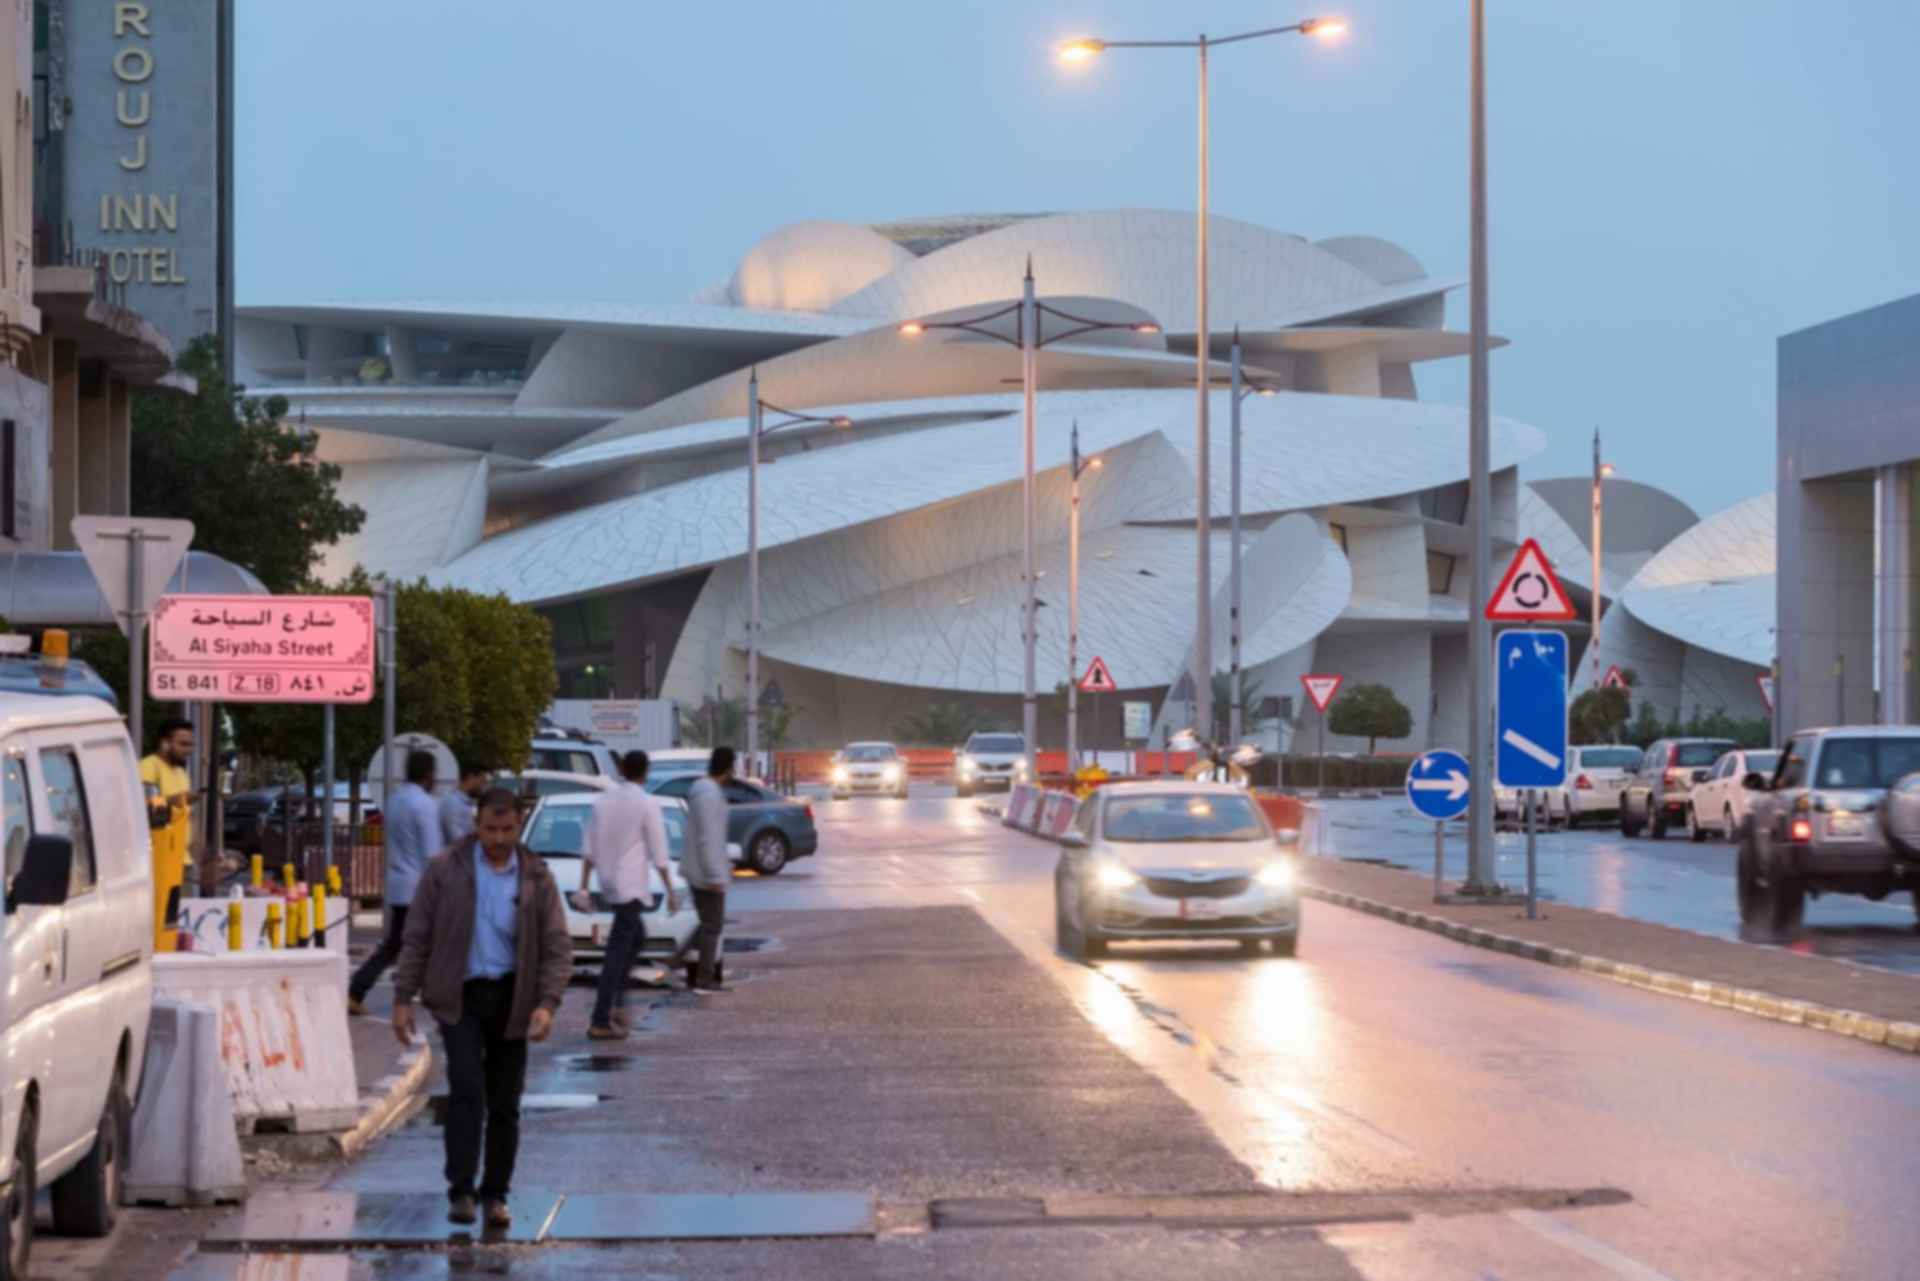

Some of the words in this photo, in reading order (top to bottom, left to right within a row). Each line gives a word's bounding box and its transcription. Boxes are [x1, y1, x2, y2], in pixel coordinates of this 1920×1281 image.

[100, 194, 178, 230] INN
[102, 247, 186, 284] OTEL
[191, 609, 272, 629] السياحة
[282, 610, 335, 632] شارع
[189, 638, 207, 653] Al
[213, 638, 272, 657] Siyaha
[278, 640, 334, 656] Street
[187, 675, 219, 690] 841
[256, 675, 275, 690] 18
[289, 676, 325, 692] ٨٤١
